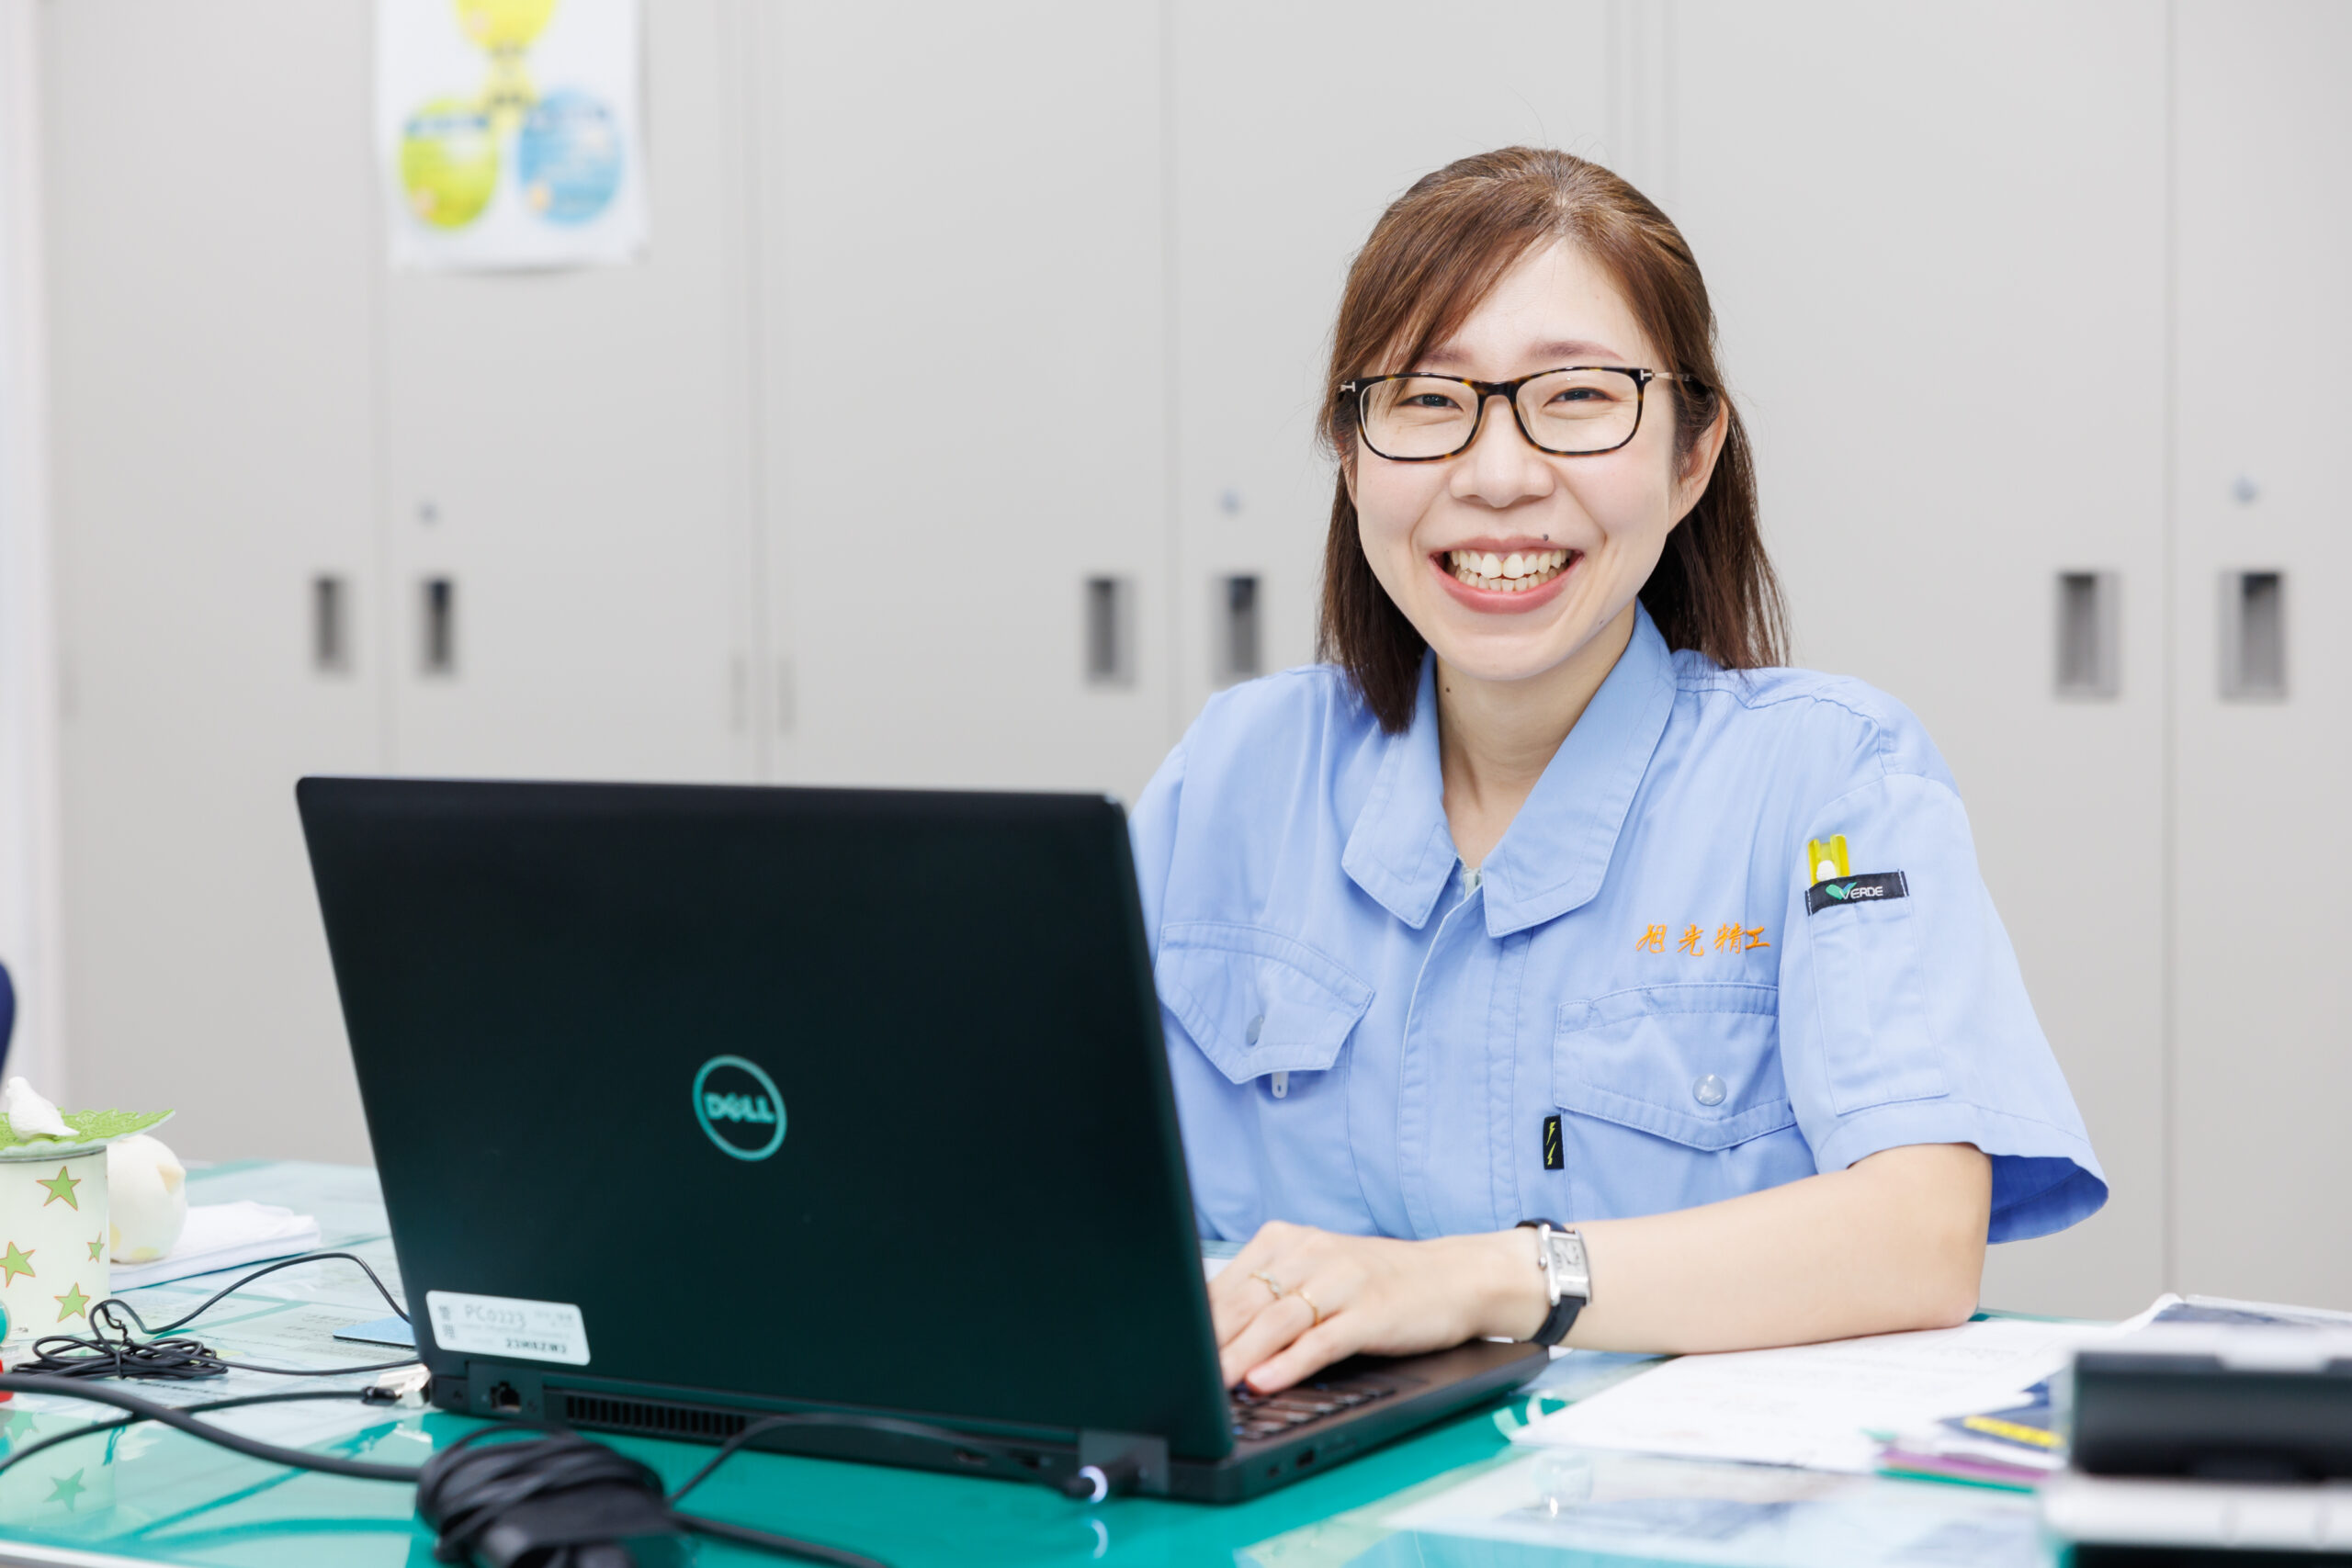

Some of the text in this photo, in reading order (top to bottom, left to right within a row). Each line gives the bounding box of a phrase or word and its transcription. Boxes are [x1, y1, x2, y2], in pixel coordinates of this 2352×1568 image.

[1839, 886, 1884, 900] VERDE
[1634, 921, 1771, 956] 旭光精工
[704, 1091, 776, 1123] DELL
